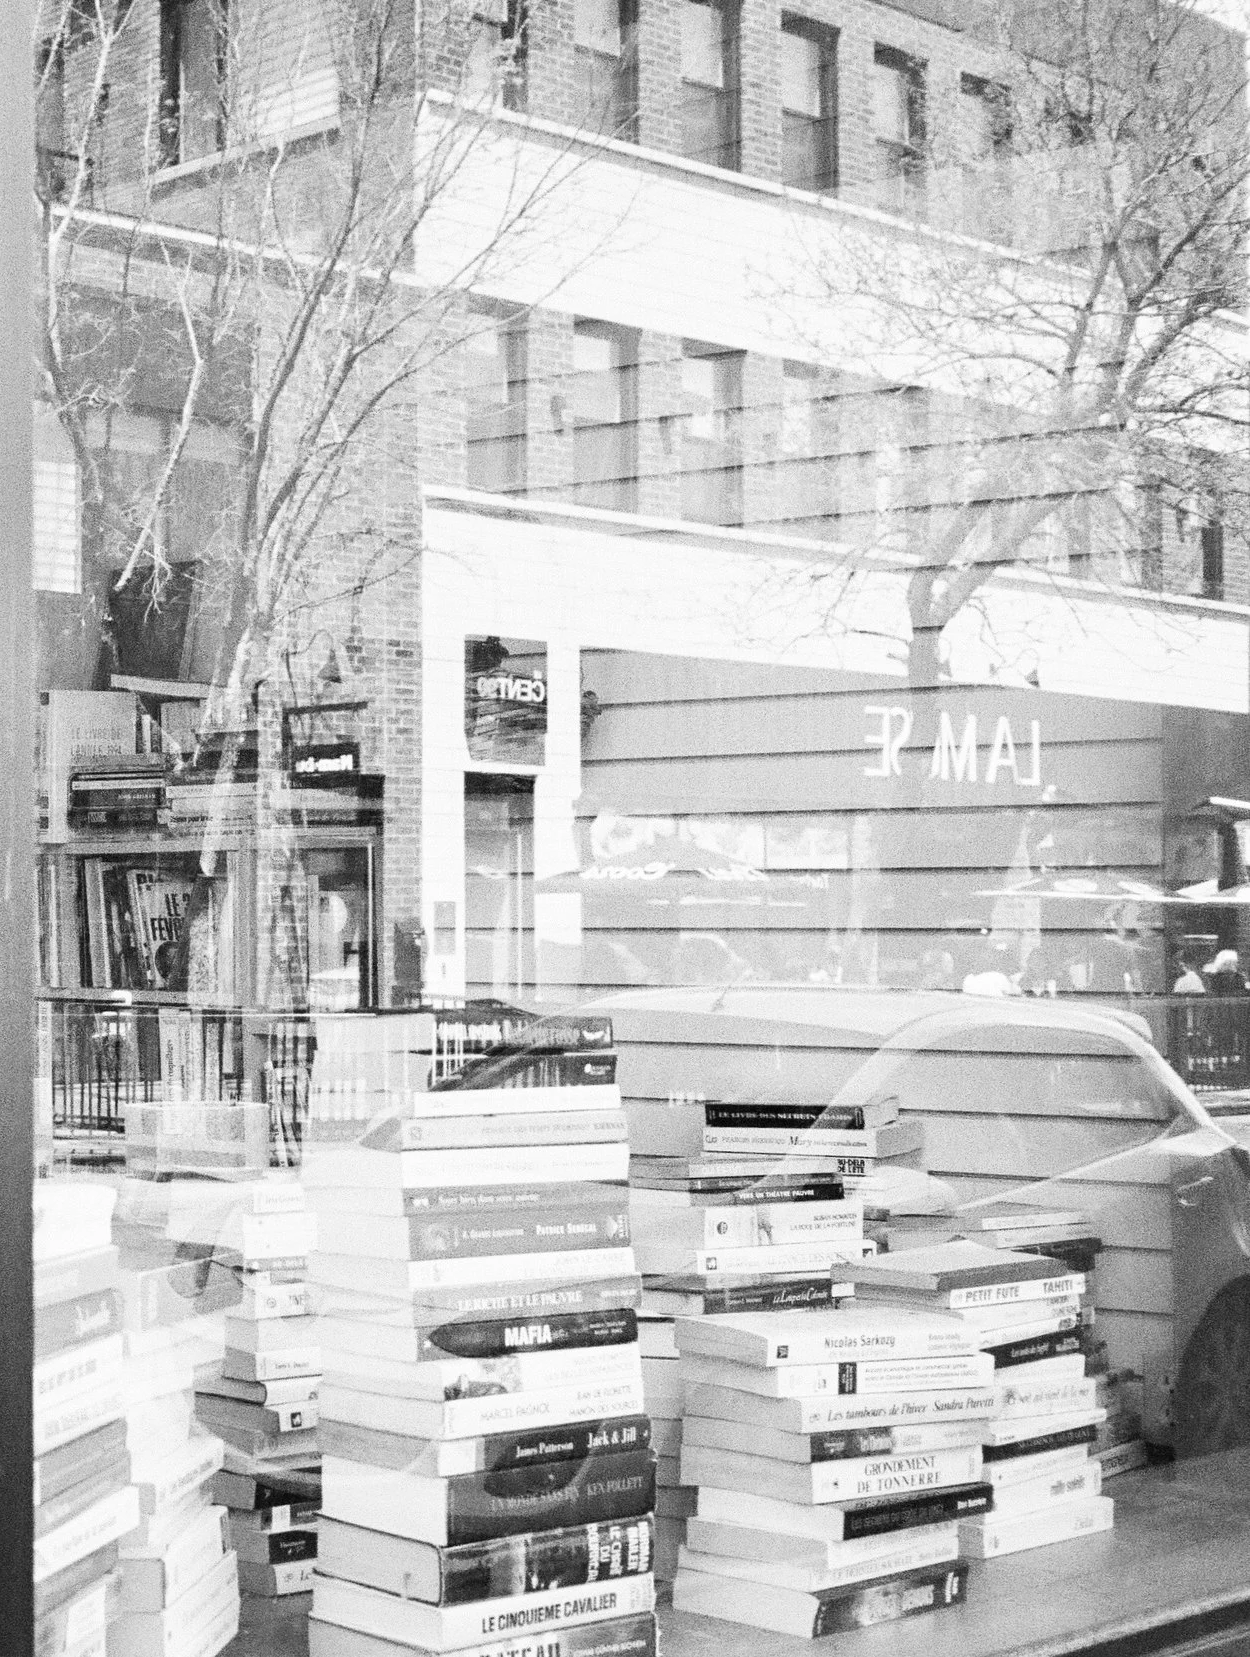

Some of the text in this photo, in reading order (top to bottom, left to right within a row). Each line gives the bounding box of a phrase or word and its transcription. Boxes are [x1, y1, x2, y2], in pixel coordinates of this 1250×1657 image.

[965, 1288, 992, 1303] PETIT
[1042, 1279, 1074, 1294] TAHITI
[504, 1324, 552, 1347] MAFIA
[824, 1336, 858, 1349] Nicolas
[860, 1334, 896, 1348] Sarkozy
[480, 1407, 513, 1422] MARCEL
[827, 1409, 843, 1422] Les
[846, 1406, 886, 1420] tambours
[889, 1404, 899, 1415] de
[933, 1400, 964, 1413] Sandra
[587, 1426, 637, 1448] Jack & Jill
[864, 1455, 937, 1477] GRONDEMENT
[857, 1471, 941, 1494] DE TONNERRE
[482, 1616, 495, 1633] LE
[563, 1592, 617, 1617] CAVALIER
